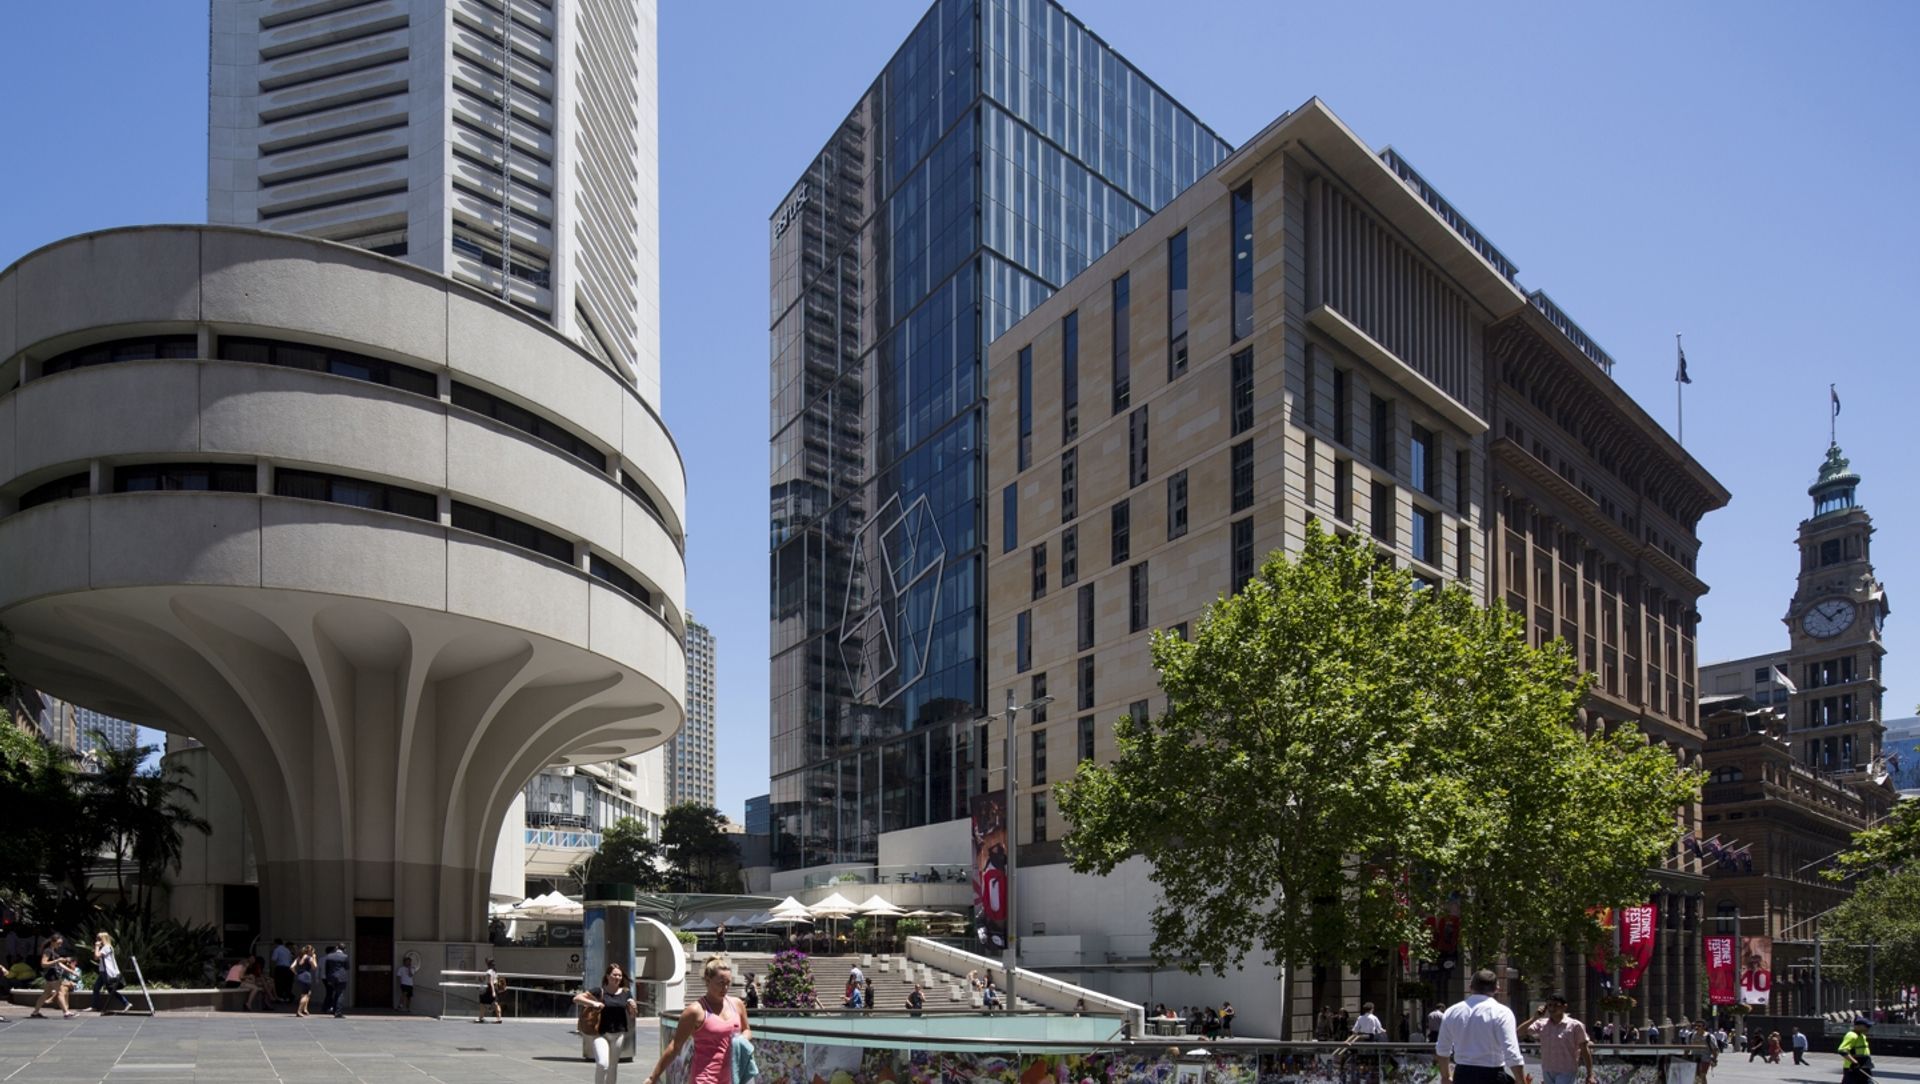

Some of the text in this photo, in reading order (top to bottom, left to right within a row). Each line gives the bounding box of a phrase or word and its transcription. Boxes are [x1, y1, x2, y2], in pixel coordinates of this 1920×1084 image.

[1629, 908, 1641, 945] FESTIVAL
[1641, 908, 1652, 938] SYDNEY
[1711, 939, 1722, 968] FESTIVAL
[1722, 939, 1731, 964] SYDNEY
[1740, 970, 1771, 992] 40
